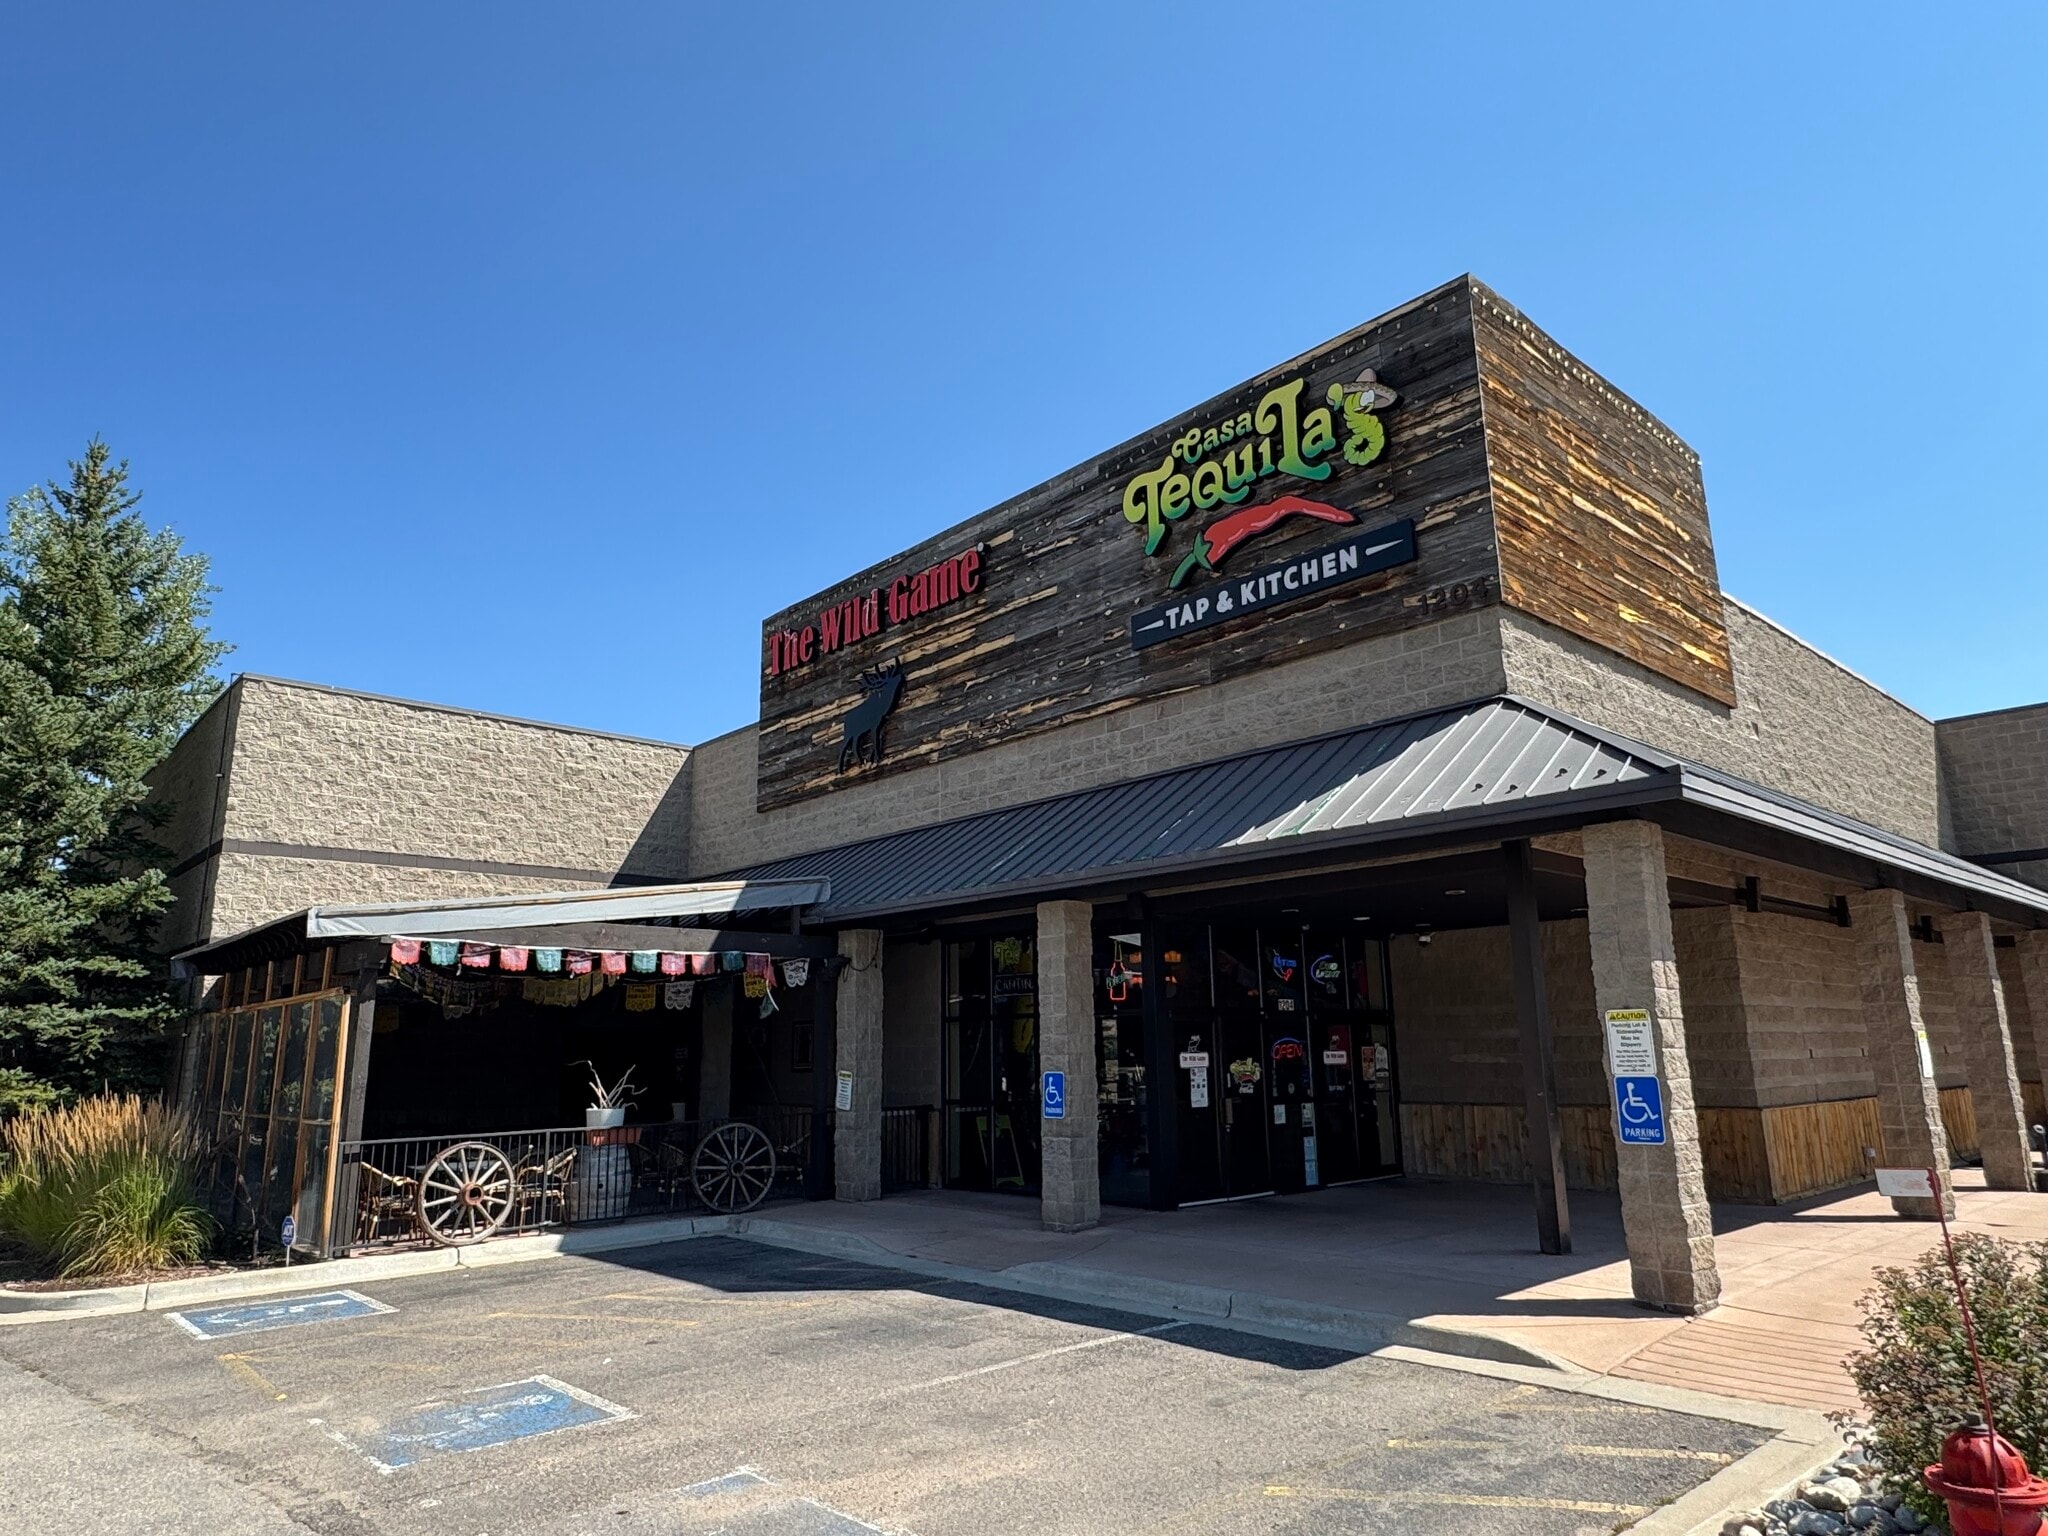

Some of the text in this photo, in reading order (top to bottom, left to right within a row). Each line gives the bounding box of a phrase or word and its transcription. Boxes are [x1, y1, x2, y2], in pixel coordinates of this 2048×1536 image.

[1172, 410, 1253, 464] Casa
[1165, 545, 1359, 630] TAP & KITCHEN
[1418, 576, 1489, 615] 1204
[769, 549, 981, 676] The Wild Game
[1616, 1012, 1647, 1020] CAUTION
[1272, 1043, 1304, 1060] OPEN
[1624, 1127, 1661, 1138] PARKING
